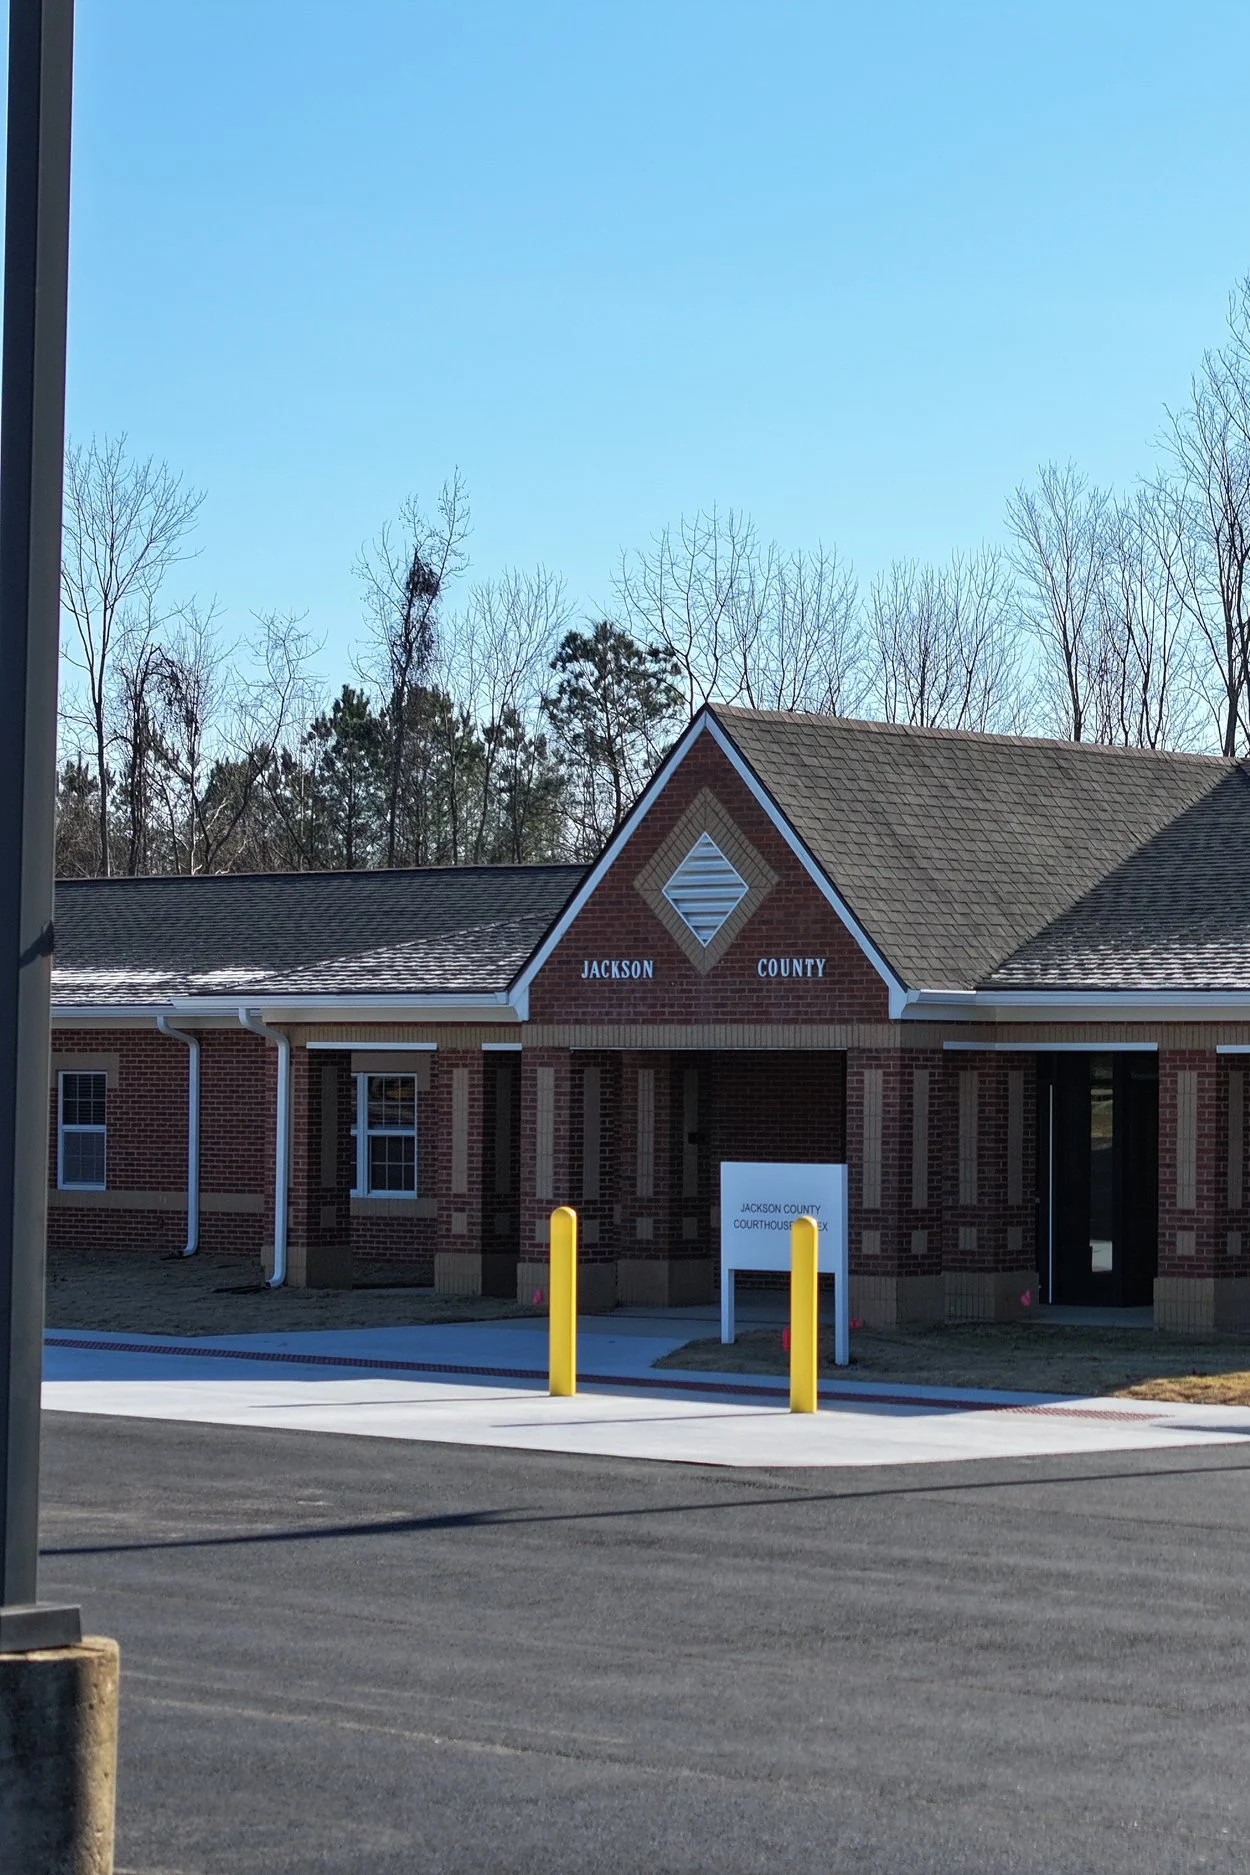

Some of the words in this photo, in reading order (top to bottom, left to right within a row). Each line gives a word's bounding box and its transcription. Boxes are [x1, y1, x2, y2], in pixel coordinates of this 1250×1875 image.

[581, 959, 655, 979] JACKSON
[757, 958, 826, 977] COUNTY
[740, 1203, 781, 1214] JACKSON
[783, 1204, 822, 1215] COUNTY
